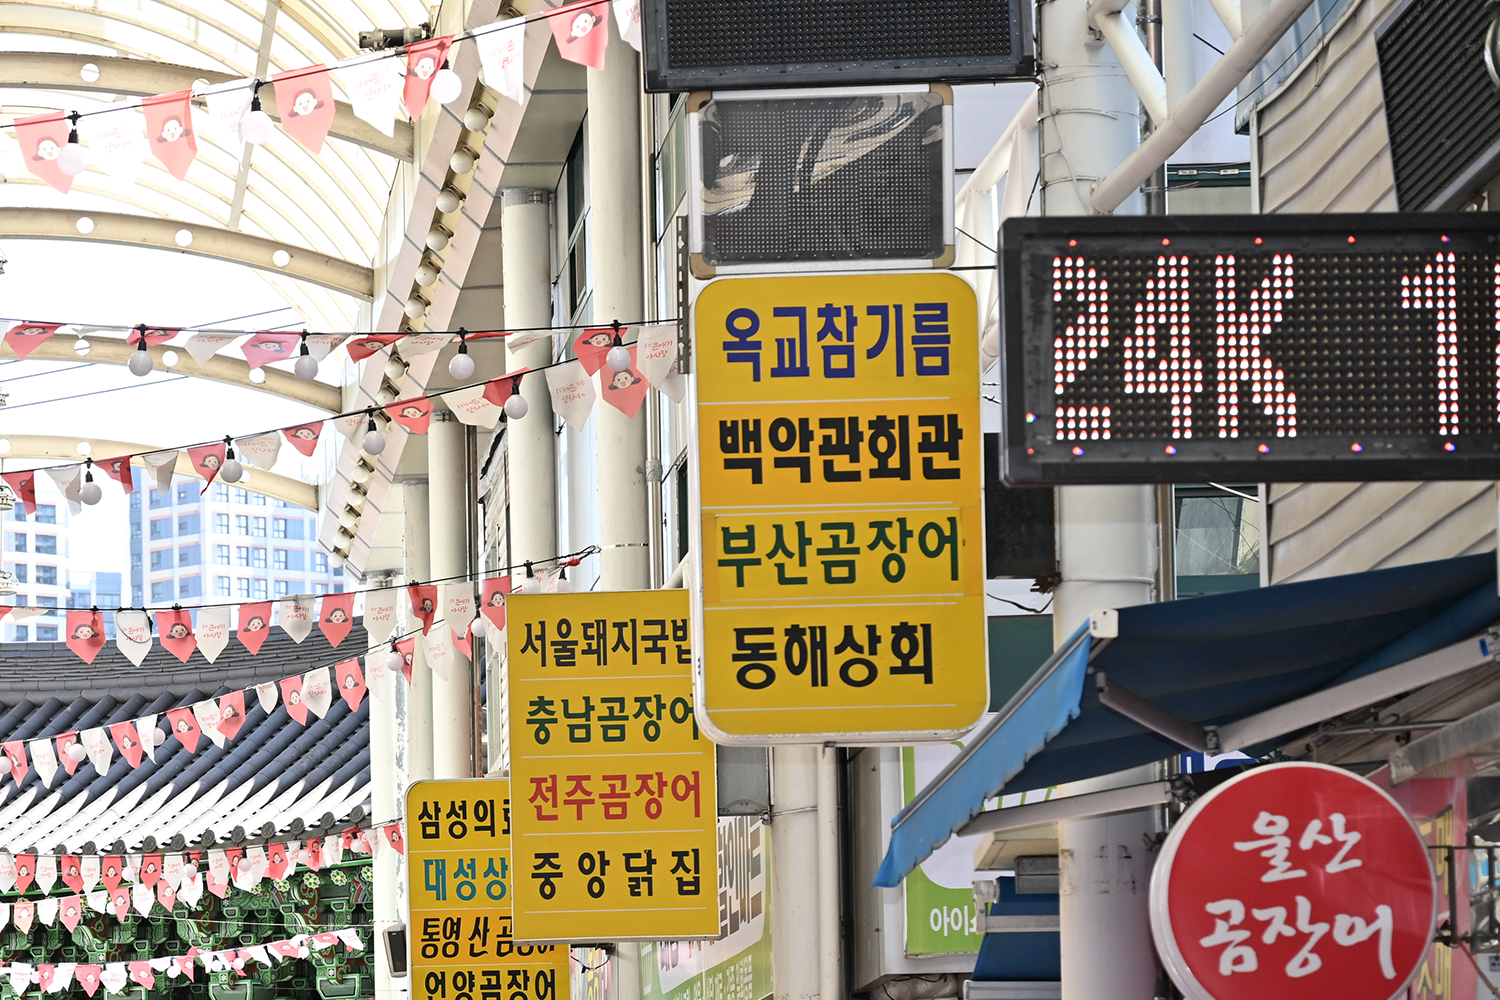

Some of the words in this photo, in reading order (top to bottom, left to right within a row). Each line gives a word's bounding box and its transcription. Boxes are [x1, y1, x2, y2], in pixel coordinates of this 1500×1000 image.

[722, 303, 951, 382] 옥교참기름
[1052, 255, 1297, 440] 24K
[1401, 250, 1500, 437] 1
[718, 413, 964, 485] 백악관회관
[718, 516, 959, 587] 부산곰장어
[731, 621, 934, 690] 동해상회
[525, 694, 700, 745] 충남곰장어
[418, 799, 510, 840] 삼성의
[528, 770, 701, 821] 전주곰장어
[1234, 810, 1362, 882] 울산
[1200, 895, 1397, 980] 곰장어
